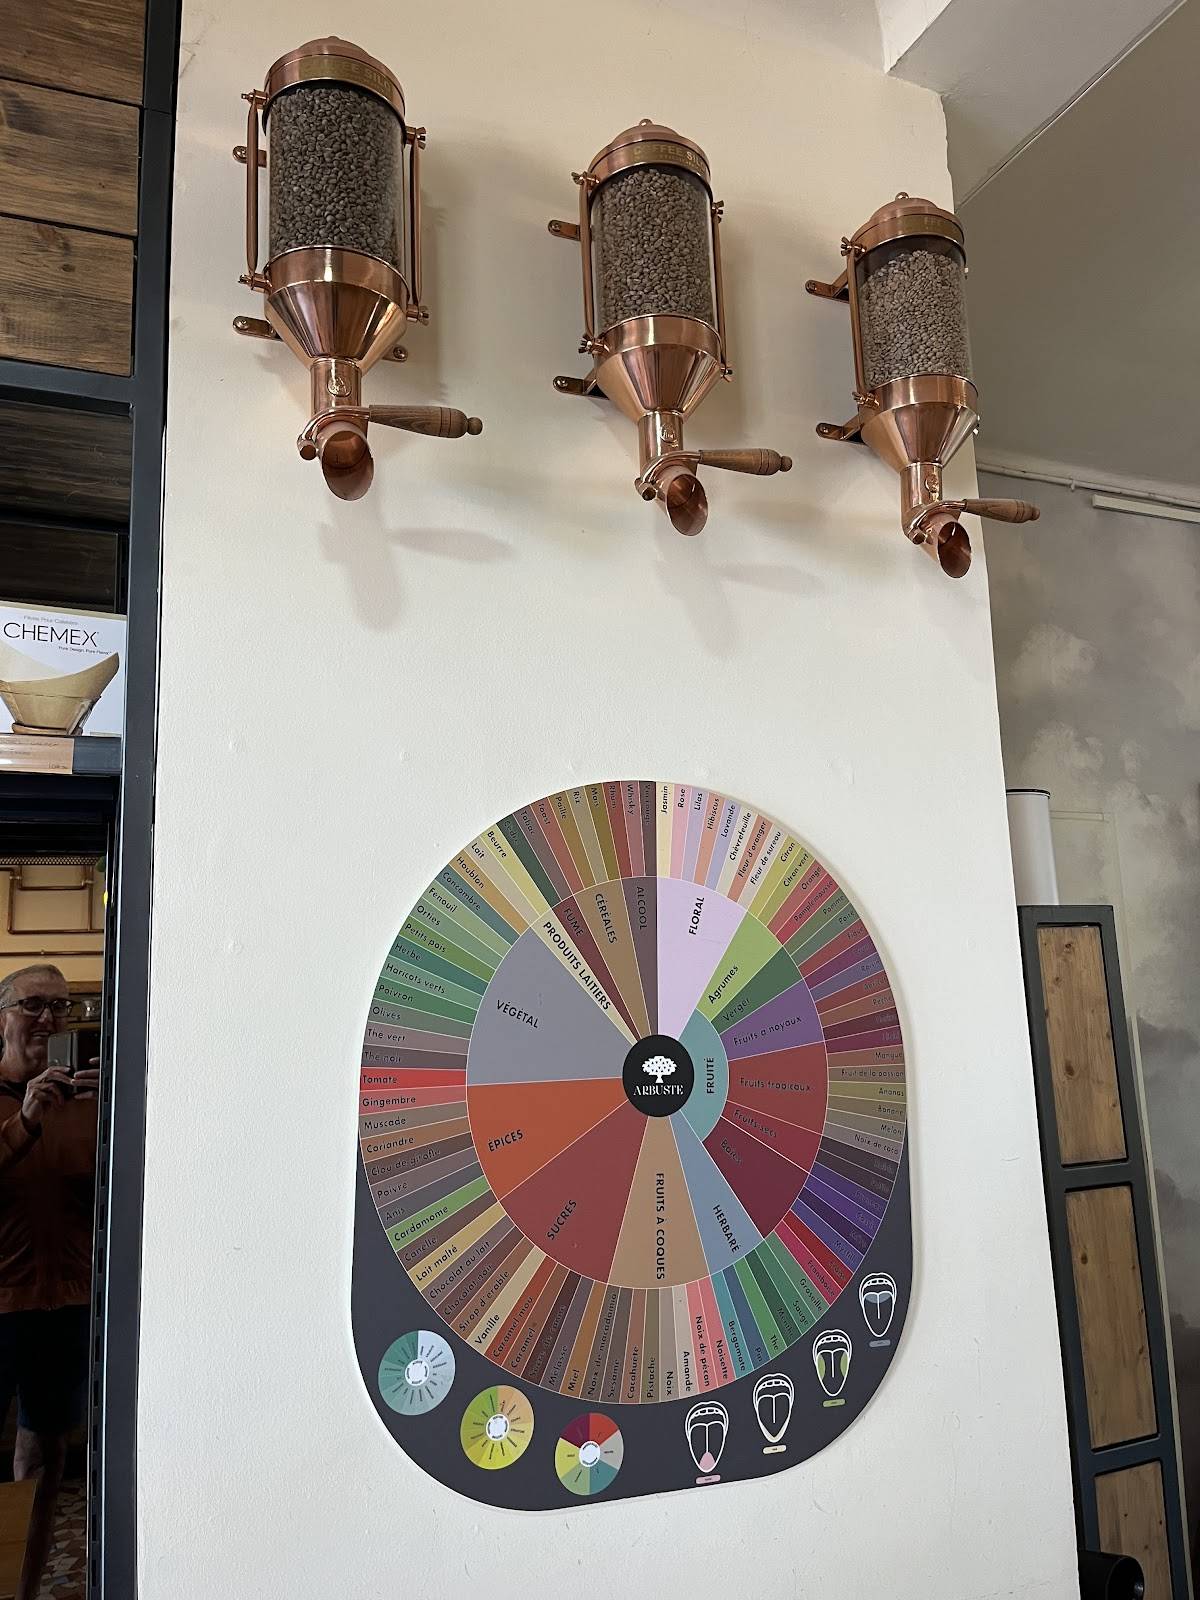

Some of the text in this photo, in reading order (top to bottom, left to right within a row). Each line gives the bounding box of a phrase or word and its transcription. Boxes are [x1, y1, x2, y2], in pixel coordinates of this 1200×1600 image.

[4, 622, 98, 647] CHEMEX
[538, 803, 550, 824] Toast
[694, 792, 702, 811] Lilas
[707, 798, 719, 830] Hibiscus
[720, 804, 735, 838] Lavande
[472, 842, 486, 860] Lait
[487, 830, 507, 858] Beurre
[750, 831, 781, 885] Fleur de sureau
[781, 842, 795, 862] Citron
[456, 856, 485, 889] Houblon
[738, 857, 750, 878] Fleur
[784, 867, 799, 887] Citron
[802, 866, 822, 890] Orange
[428, 888, 457, 913] Fenouil
[442, 872, 481, 911] Concombre
[417, 905, 441, 926] Orties
[595, 893, 617, 944] CÉRÉALES
[636, 886, 647, 930] ALCOOL
[689, 897, 705, 935] FLORAL
[395, 943, 421, 961] Herbe
[405, 923, 446, 953] Petits pois
[386, 963, 445, 994] Haricots verts
[543, 922, 611, 1010] PRODUITS LAITIERS
[378, 984, 413, 1002] Poivron
[708, 965, 739, 1004] Agrumes
[372, 1006, 401, 1020] Olives
[497, 1000, 538, 1028] VÉGÉTAL
[723, 998, 750, 1022] Verger
[387, 1034, 406, 1042] vert
[734, 1030, 758, 1047] Fruits
[768, 1016, 802, 1034] noyaux
[363, 1075, 397, 1084] Tomate
[703, 1057, 714, 1094] FRUITÉ
[740, 1077, 811, 1092] Fruits tropicaux
[362, 1096, 416, 1108] Gingembre
[633, 1084, 684, 1096] ARBUSTE
[364, 1116, 406, 1130] Muscade
[366, 1136, 414, 1153] Coriandre
[488, 1129, 523, 1152] ÉPICES
[854, 1134, 870, 1145] Noix
[371, 1162, 392, 1176] Clou
[395, 1159, 407, 1169] de
[378, 1182, 408, 1199] Poivre
[656, 1172, 665, 1212] FRUITS
[394, 1206, 449, 1241] Cardamome
[416, 1244, 458, 1282] Lait malté
[656, 1228, 666, 1280] COQUES
[430, 1241, 491, 1299] Chocolat au lait
[444, 1280, 477, 1316] Chocolat
[800, 1278, 823, 1312] Groseille
[459, 1308, 480, 1332] Sirop
[475, 1314, 500, 1344] Vanille
[494, 1296, 533, 1358] Caramel mou
[511, 1327, 536, 1368] Caramel
[700, 1344, 706, 1356] de
[729, 1320, 746, 1371] Bergamote
[683, 1351, 691, 1392] Amande
[716, 1340, 728, 1380] Noisette
[568, 1369, 580, 1391] Miel
[588, 1372, 598, 1395] Noix
[647, 1357, 656, 1398] Pistache
